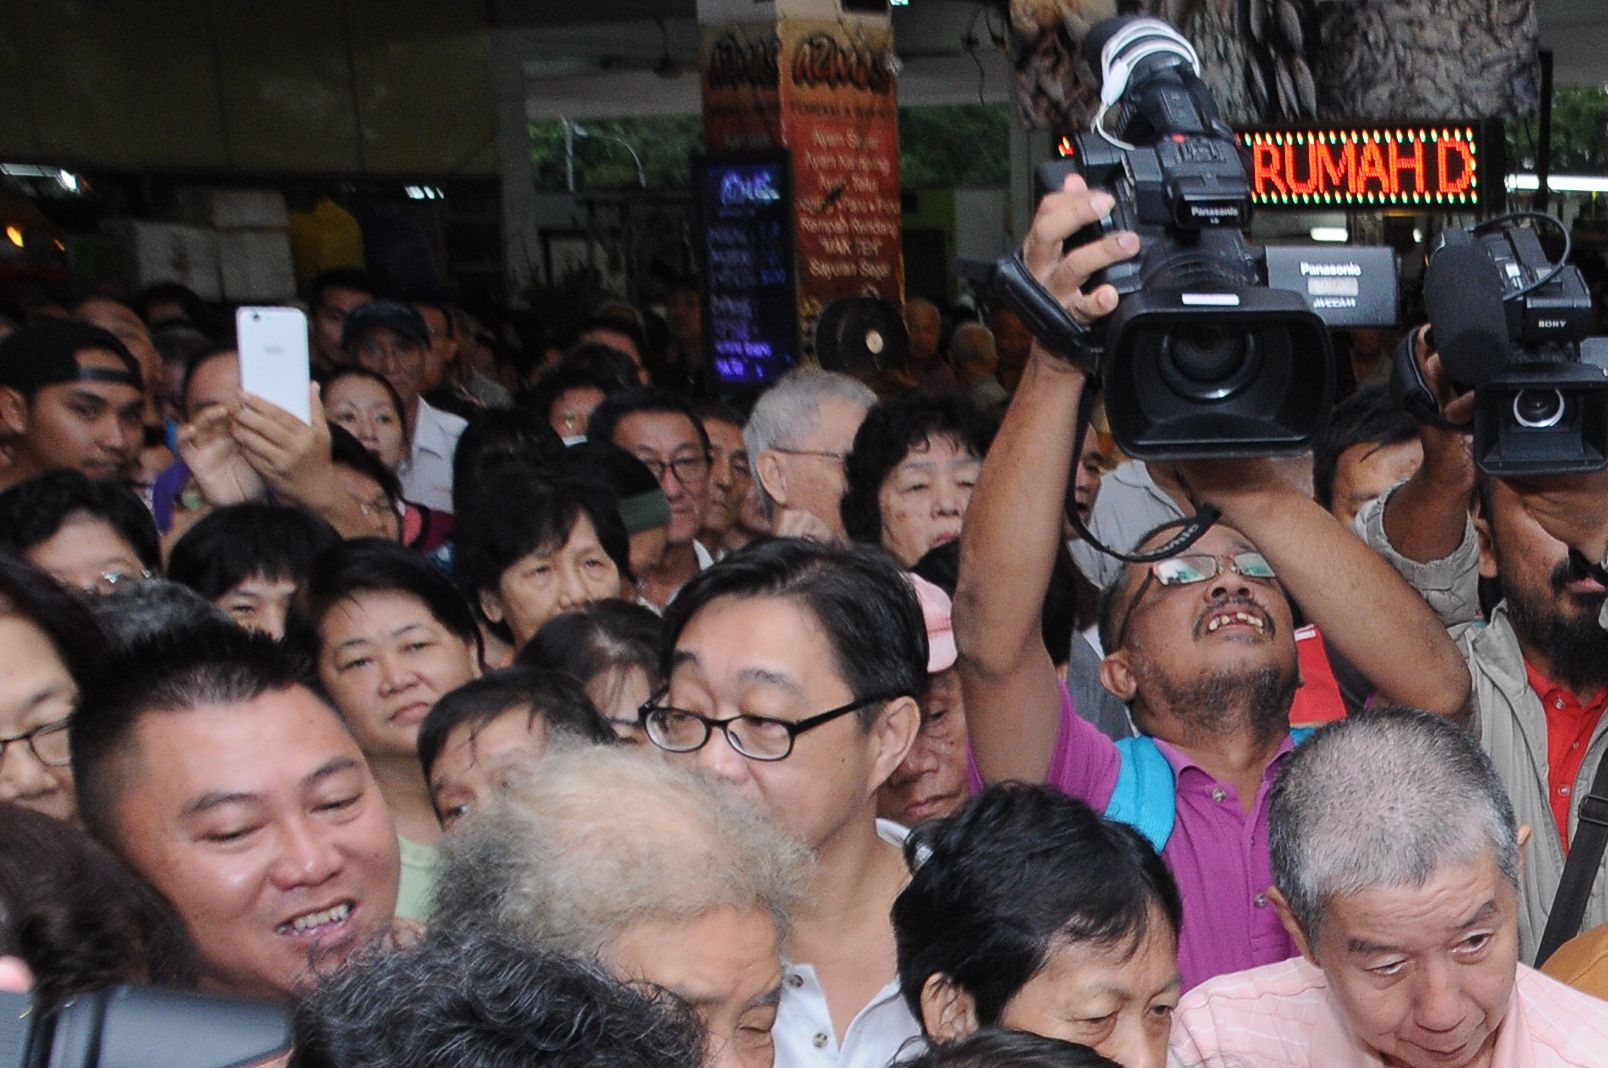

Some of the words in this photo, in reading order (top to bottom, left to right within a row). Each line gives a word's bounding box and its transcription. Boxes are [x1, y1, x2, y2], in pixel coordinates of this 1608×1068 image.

[1253, 137, 1424, 194] RUMAH
[1438, 137, 1475, 193] D
[1191, 206, 1239, 217] Panasonic
[1300, 262, 1362, 276] Panasonic
[1538, 320, 1567, 329] SONY
